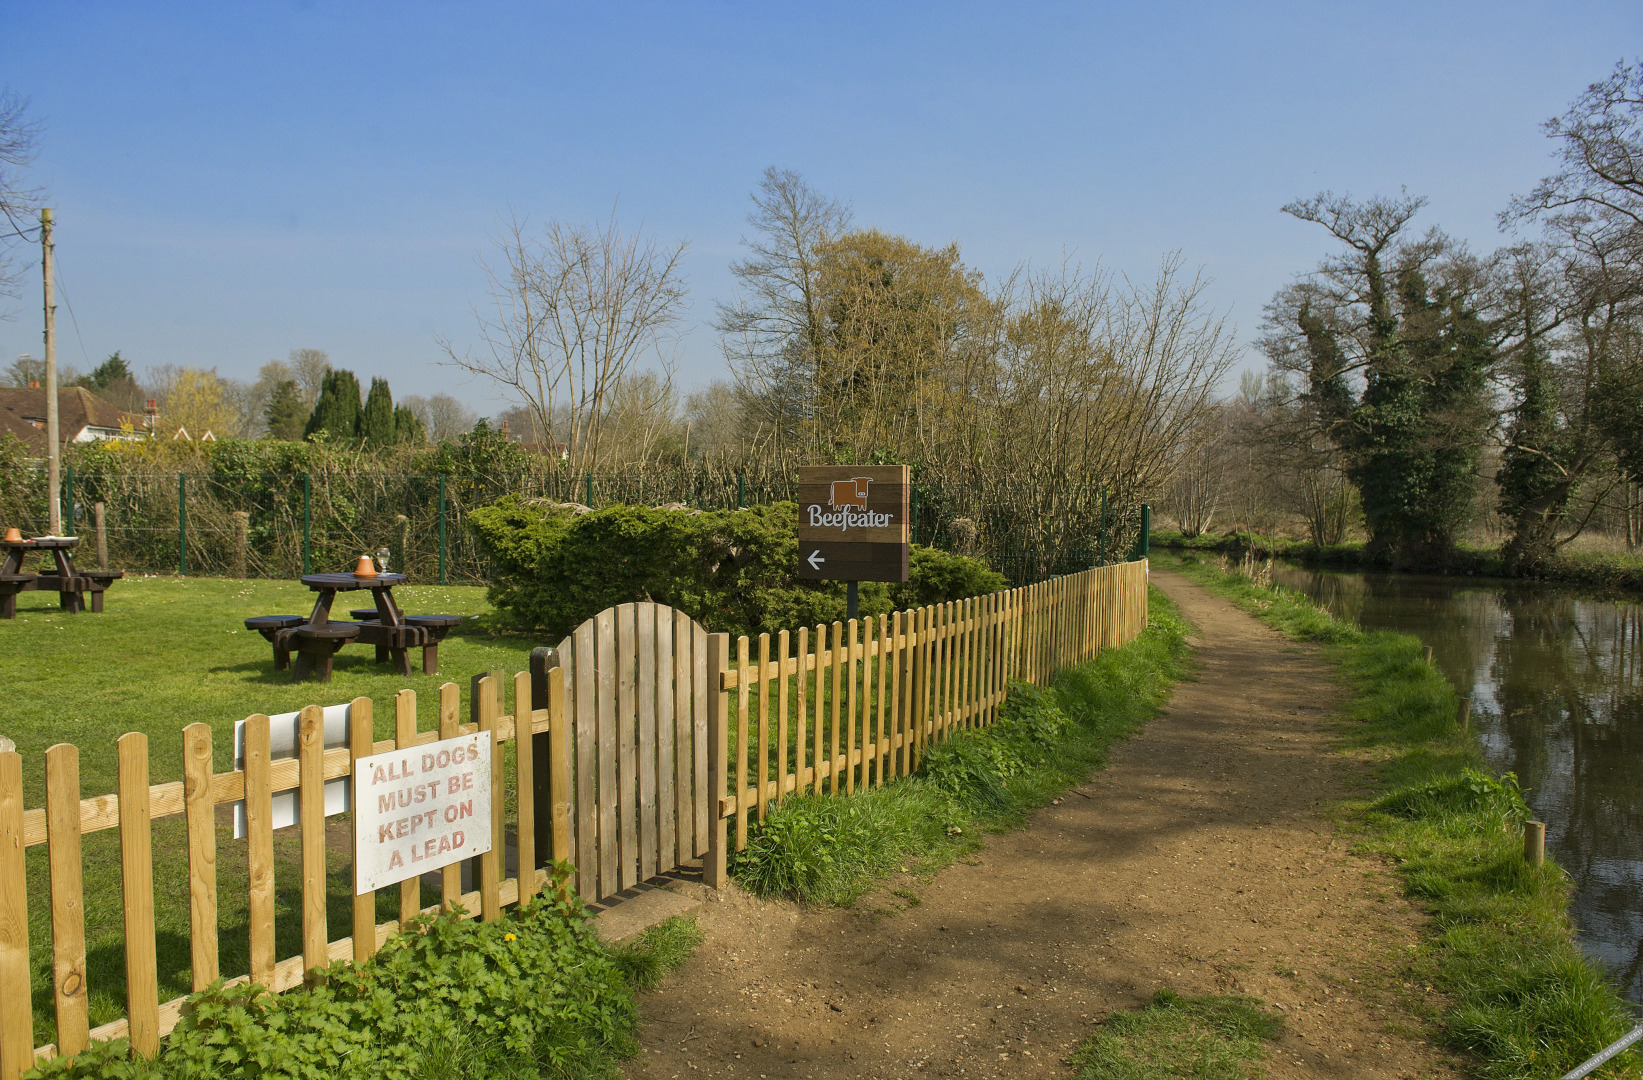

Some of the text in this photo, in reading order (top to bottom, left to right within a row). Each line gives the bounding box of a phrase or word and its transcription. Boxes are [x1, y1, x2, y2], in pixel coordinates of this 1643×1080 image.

[807, 504, 893, 532] Beefeater
[372, 743, 478, 785] ALL DOGS
[378, 772, 473, 814] MUST BE
[379, 800, 472, 844] KEPT ON
[389, 831, 464, 871] A LEAD
